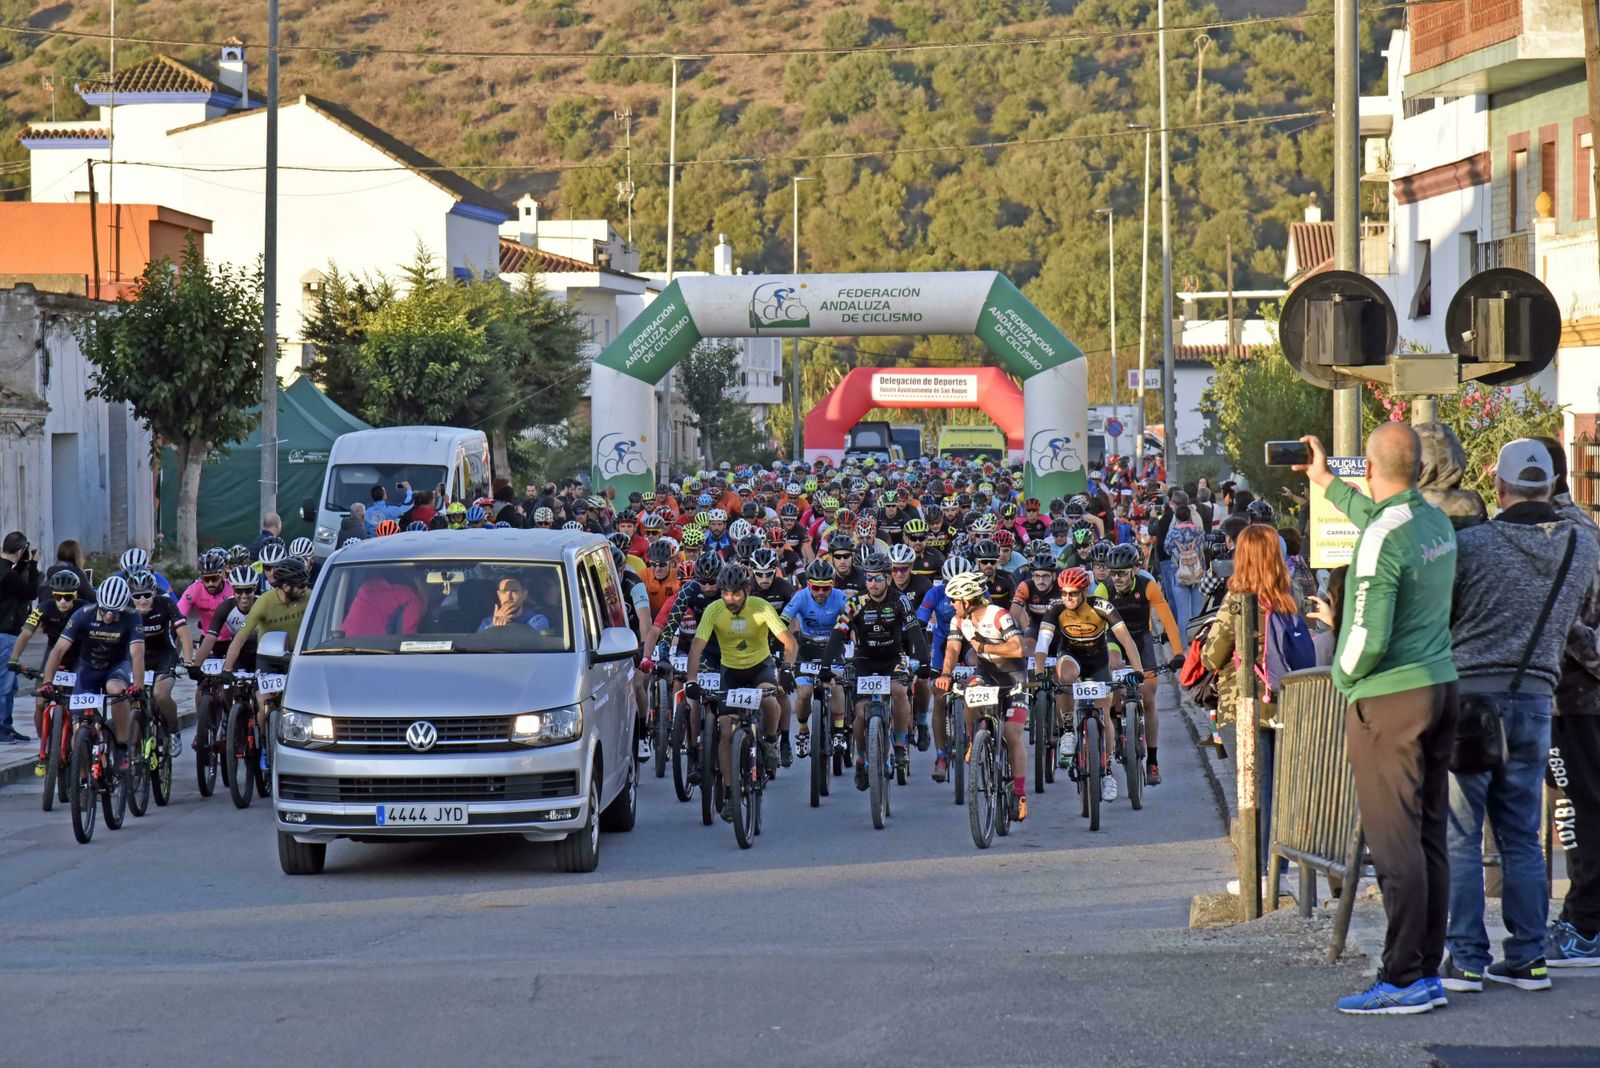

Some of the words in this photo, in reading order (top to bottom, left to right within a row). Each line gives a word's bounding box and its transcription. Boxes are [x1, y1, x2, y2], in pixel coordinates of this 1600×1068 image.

[838, 287, 920, 298] FEDERACIÓN
[820, 301, 891, 311] ANDALUZA
[841, 313, 859, 322] DE
[862, 313, 922, 322] CICLISMO
[988, 306, 1031, 348] ANDALUZA
[642, 350, 656, 364] DE
[654, 315, 689, 352] CICLISMO
[625, 326, 667, 369] ANDALUZA
[994, 324, 1008, 337] DE
[1006, 335, 1043, 370] CICLISMO
[879, 376, 921, 386] Delegación
[923, 377, 932, 386] de
[934, 377, 967, 386] Deportes
[860, 681, 883, 691] 206
[1076, 686, 1099, 697] 065
[72, 695, 95, 705] 330
[731, 693, 752, 705] 114
[388, 808, 428, 823] 4444
[434, 808, 463, 822] JYD
